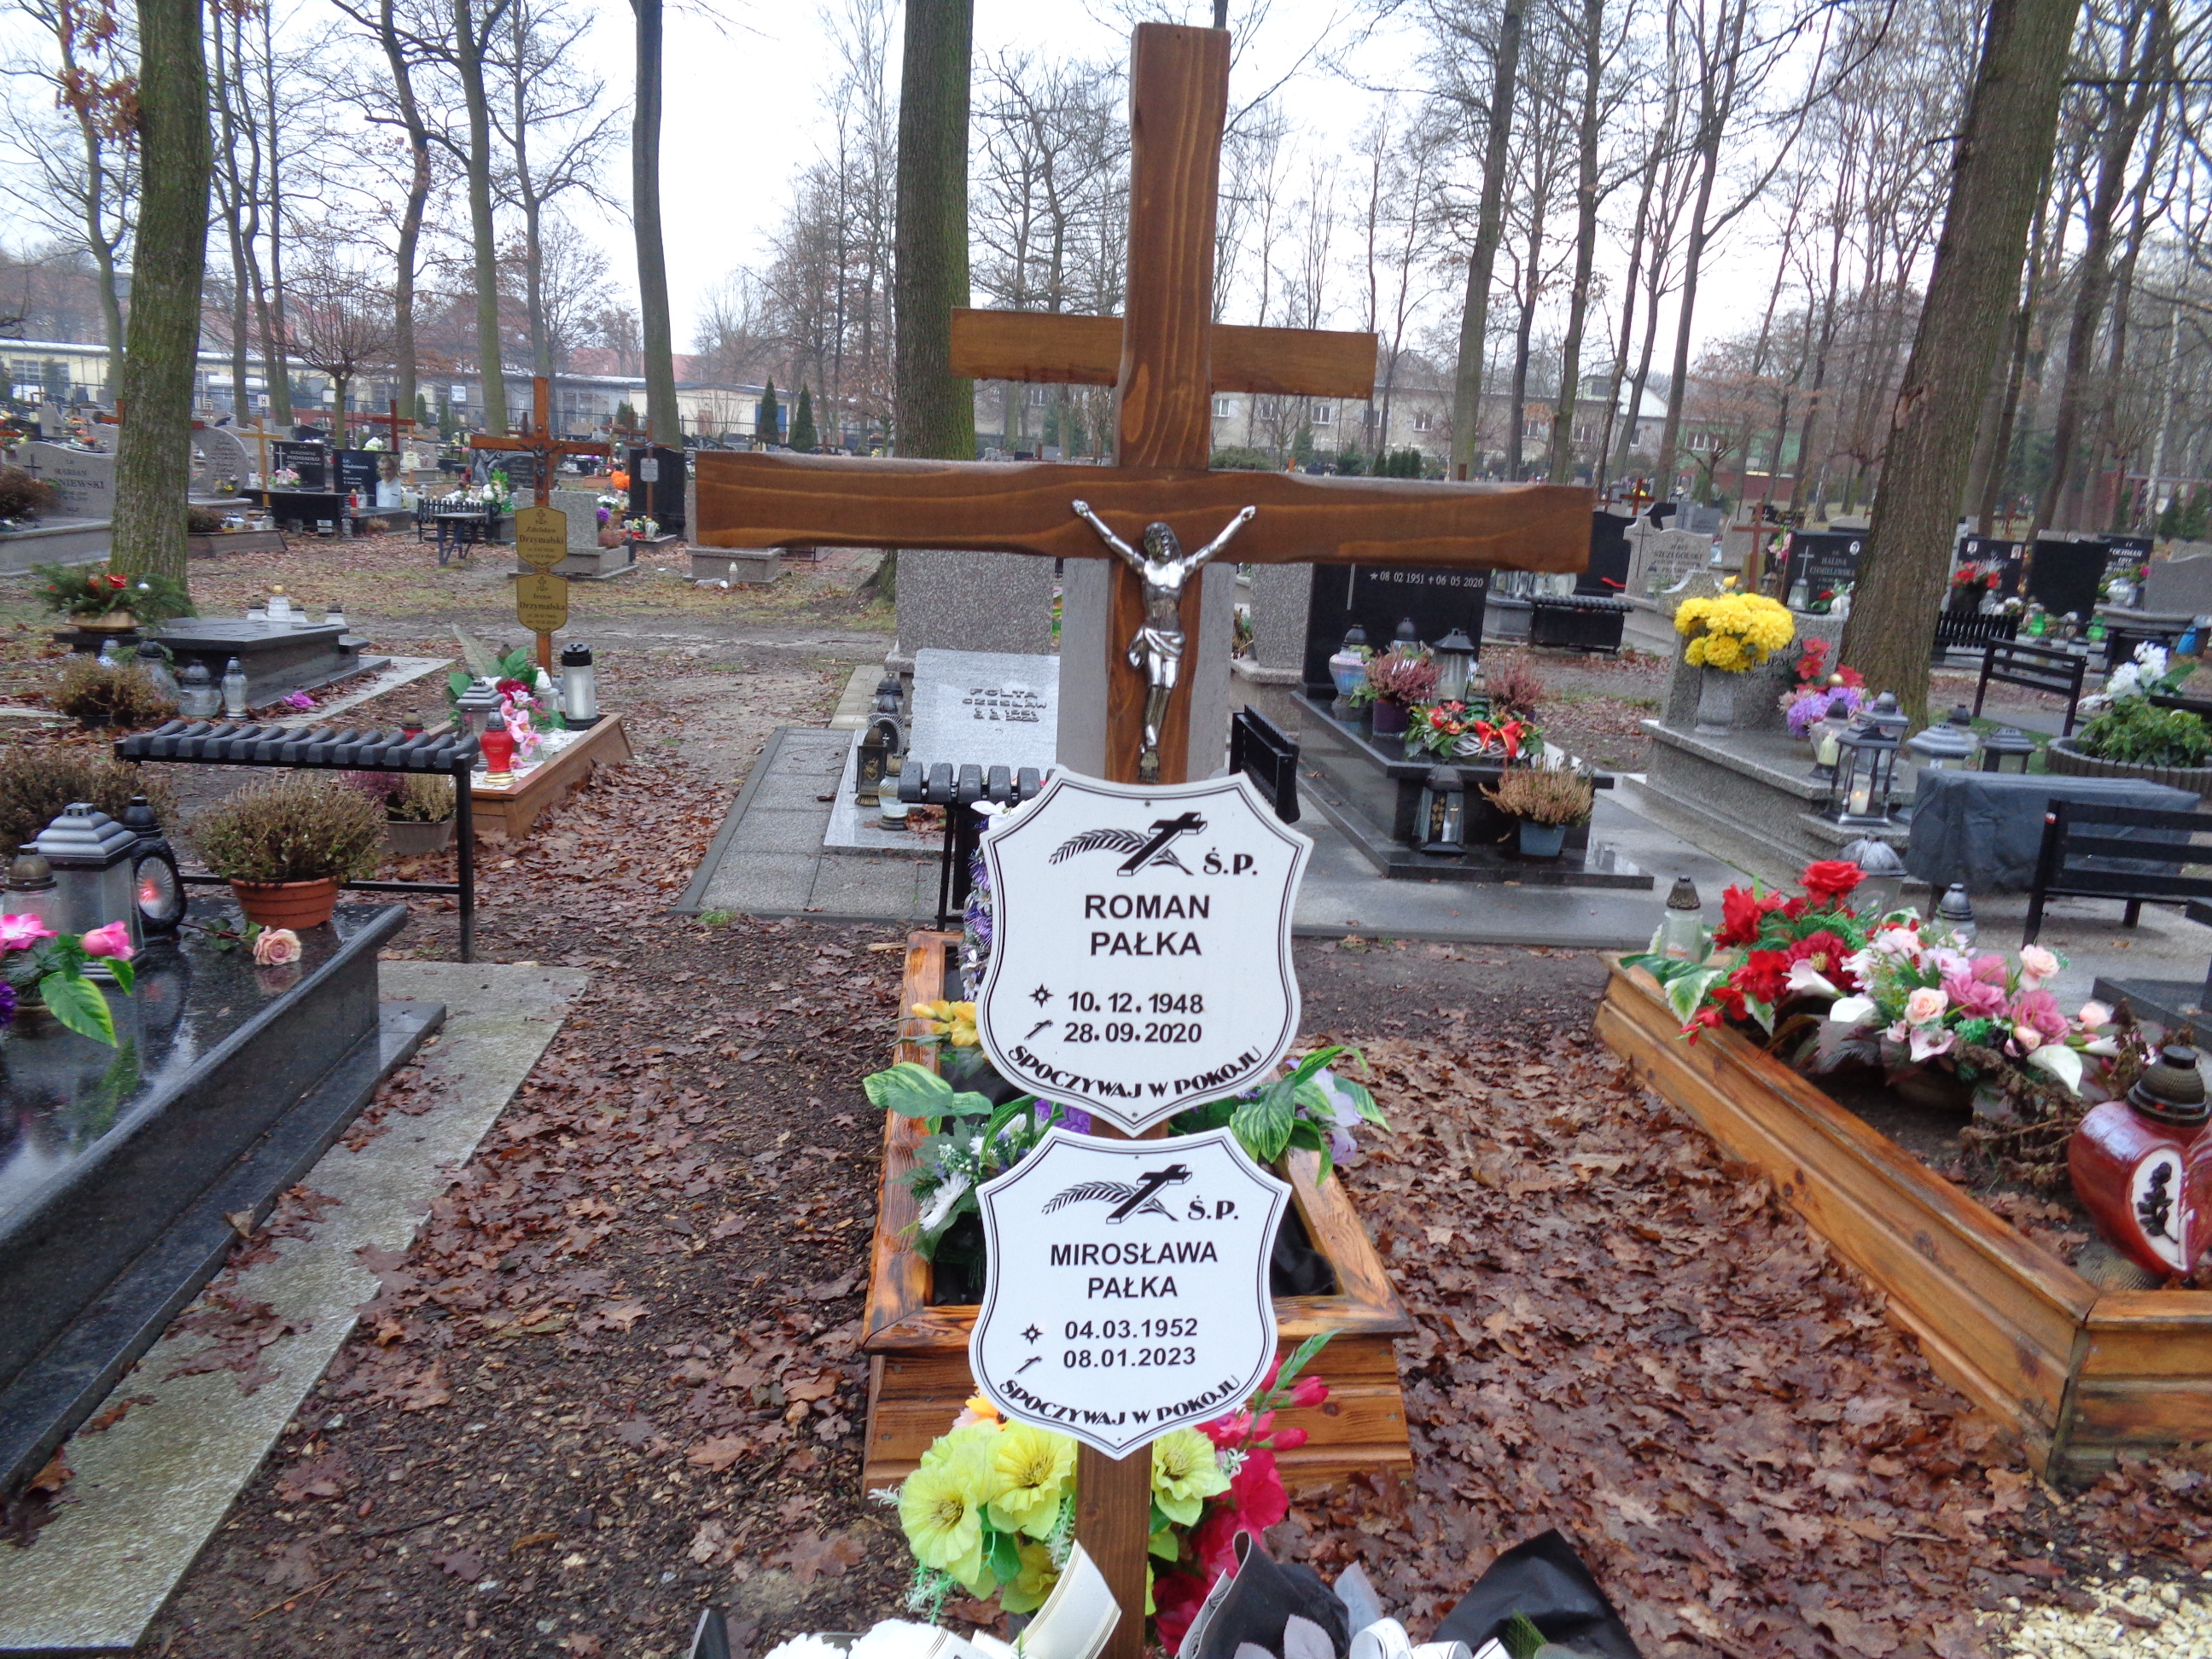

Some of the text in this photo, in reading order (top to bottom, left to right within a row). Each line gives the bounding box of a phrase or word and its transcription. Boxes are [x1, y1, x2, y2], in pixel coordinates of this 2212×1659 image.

[1379, 570, 1391, 582] 08
[1393, 571, 1405, 583] 02
[1406, 572, 1426, 585] 1951
[1435, 574, 1447, 586] 06
[1463, 576, 1484, 589] 2020
[969, 687, 1038, 699] FOLTA
[1202, 846, 1259, 876] Ś.P.
[1084, 894, 1210, 920] ROMAN
[1090, 930, 1202, 957] PAŁKA
[1008, 1045, 1263, 1099] SPOCZYWAJ W POKOJU
[1187, 1195, 1240, 1221] Ś.P.
[1050, 1241, 1219, 1267] MIROSŁAWA
[1086, 1276, 1179, 1300] PAŁKA
[1064, 1318, 1199, 1340] 04.03.1952
[1062, 1347, 1196, 1369] 08.01.2023
[998, 1374, 1242, 1426] SPOCZYWAJ W POKOJU
